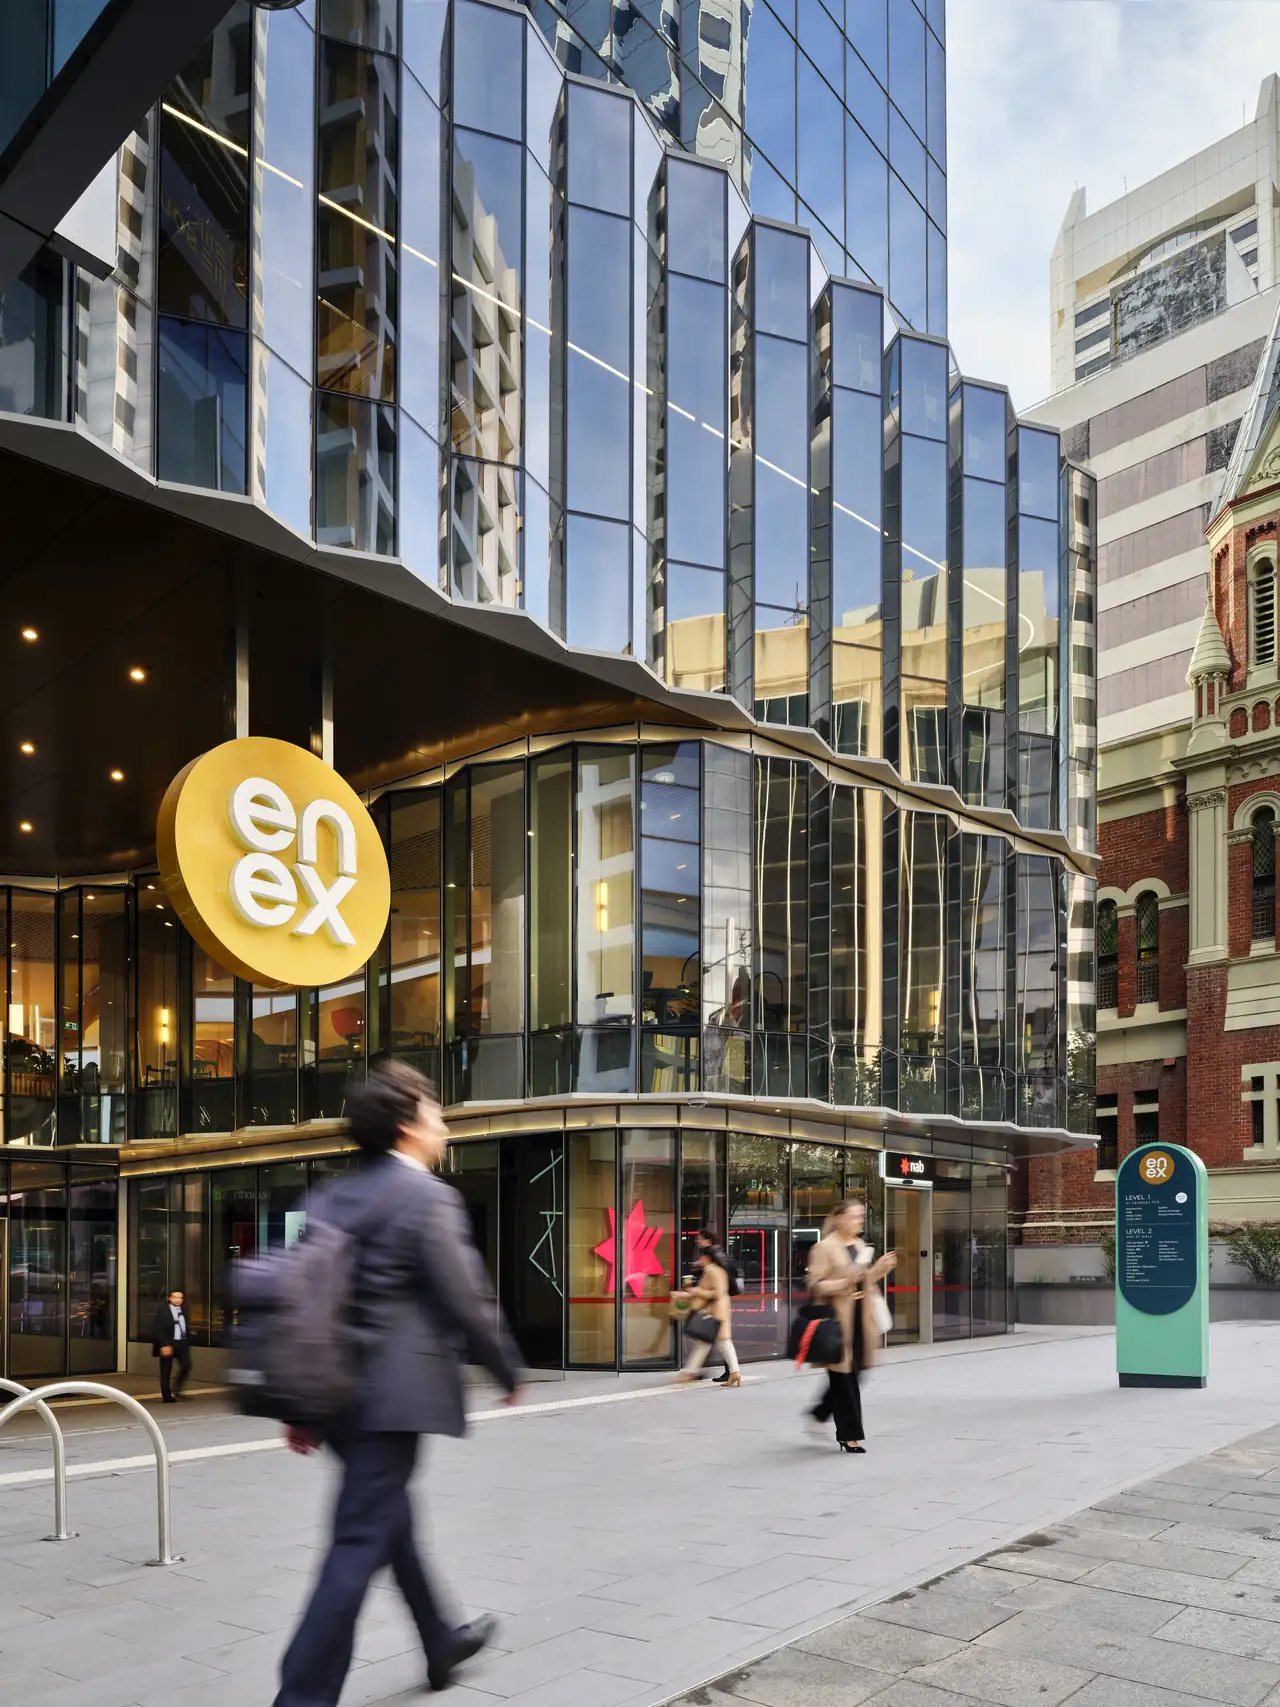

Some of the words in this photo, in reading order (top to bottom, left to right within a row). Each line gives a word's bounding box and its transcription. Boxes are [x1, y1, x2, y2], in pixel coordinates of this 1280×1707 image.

[228, 777, 357, 875] en
[228, 852, 358, 947] ex
[910, 1160, 925, 1173] nab
[1145, 1157, 1167, 1169] en
[1145, 1168, 1167, 1179] ex
